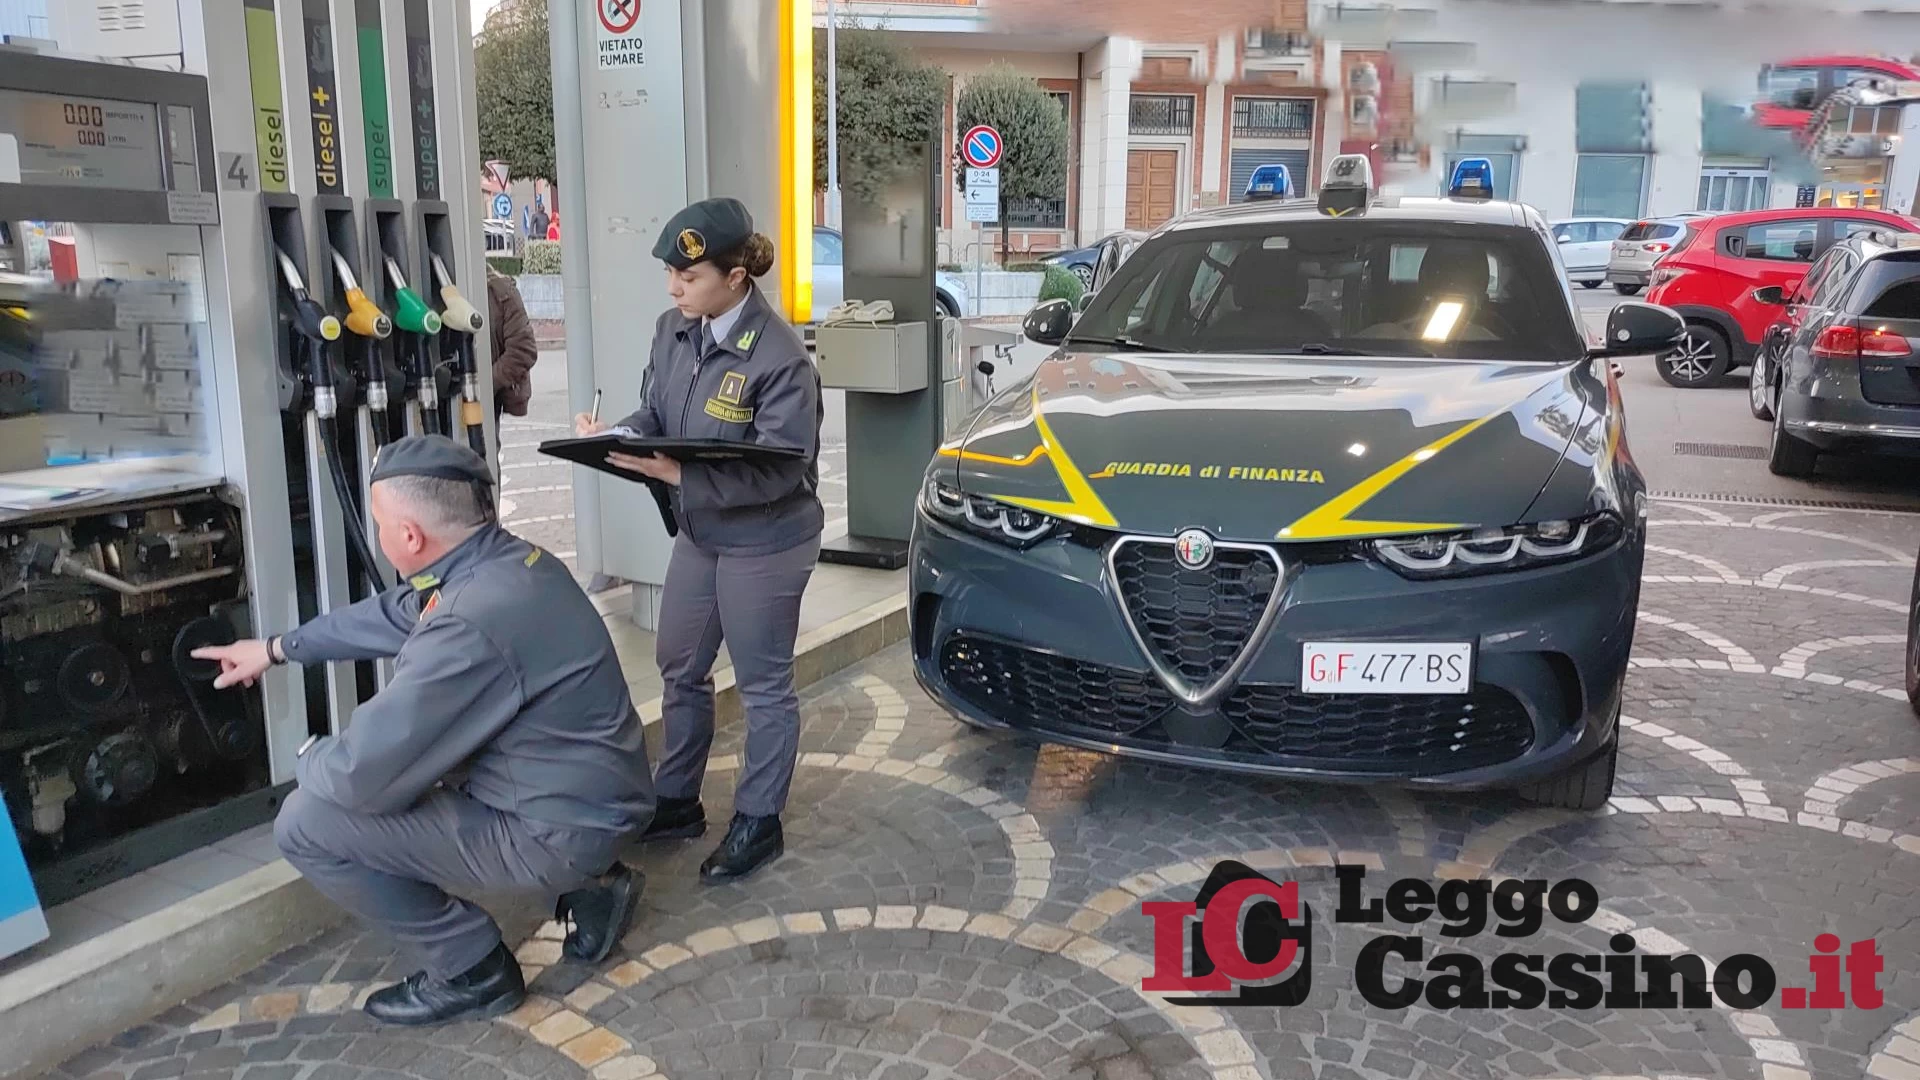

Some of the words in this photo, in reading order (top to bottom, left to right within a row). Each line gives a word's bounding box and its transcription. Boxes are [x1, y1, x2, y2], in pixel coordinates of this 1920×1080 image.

[599, 38, 643, 52] VIETATO
[600, 53, 644, 66] FUMARE
[63, 103, 103, 127] 0.00
[260, 108, 285, 183] diesel
[312, 113, 337, 187] diesel
[371, 120, 391, 188] super
[420, 128, 437, 192] super
[227, 155, 248, 189] 4
[1103, 461, 1191, 477] GUARDIA
[1199, 466, 1221, 478] di
[1228, 466, 1325, 483] FINANZA
